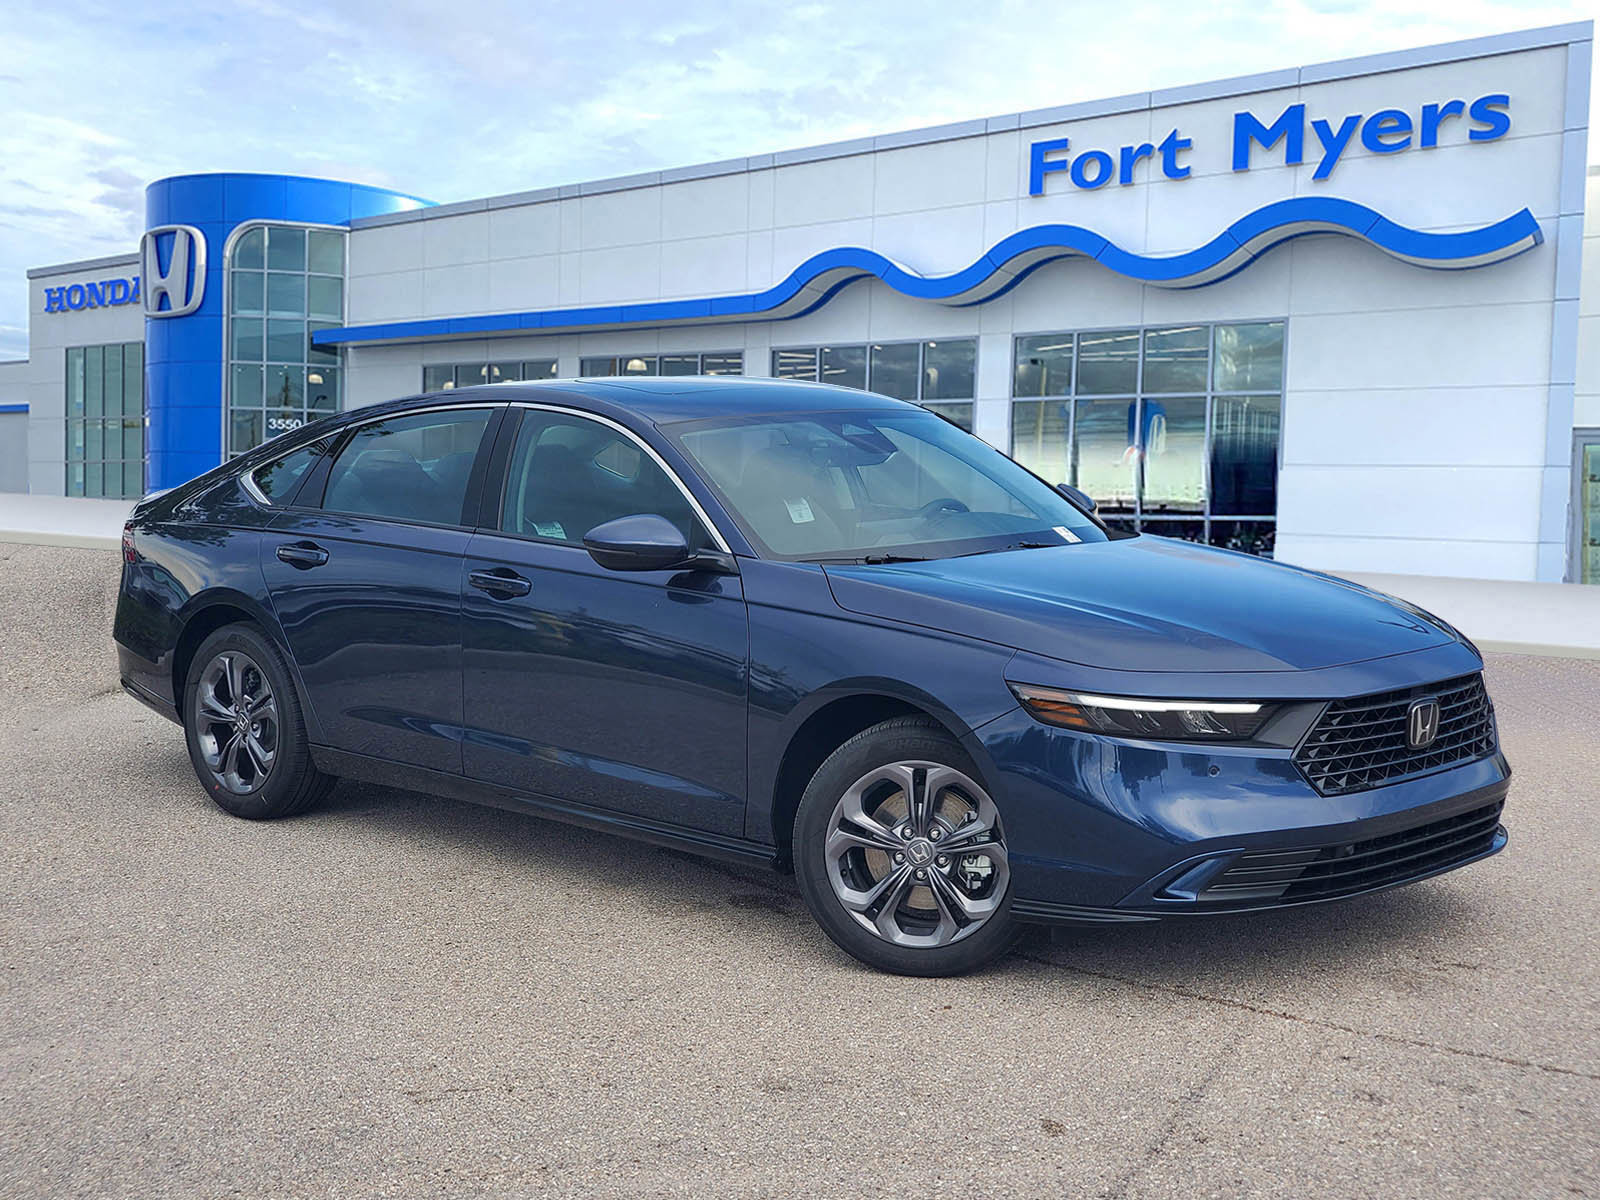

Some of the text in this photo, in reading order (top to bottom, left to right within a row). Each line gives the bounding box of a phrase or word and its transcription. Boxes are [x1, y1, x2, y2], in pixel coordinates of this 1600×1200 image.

[1029, 94, 1511, 196] Fort Myers
[268, 418, 302, 430] 3550
